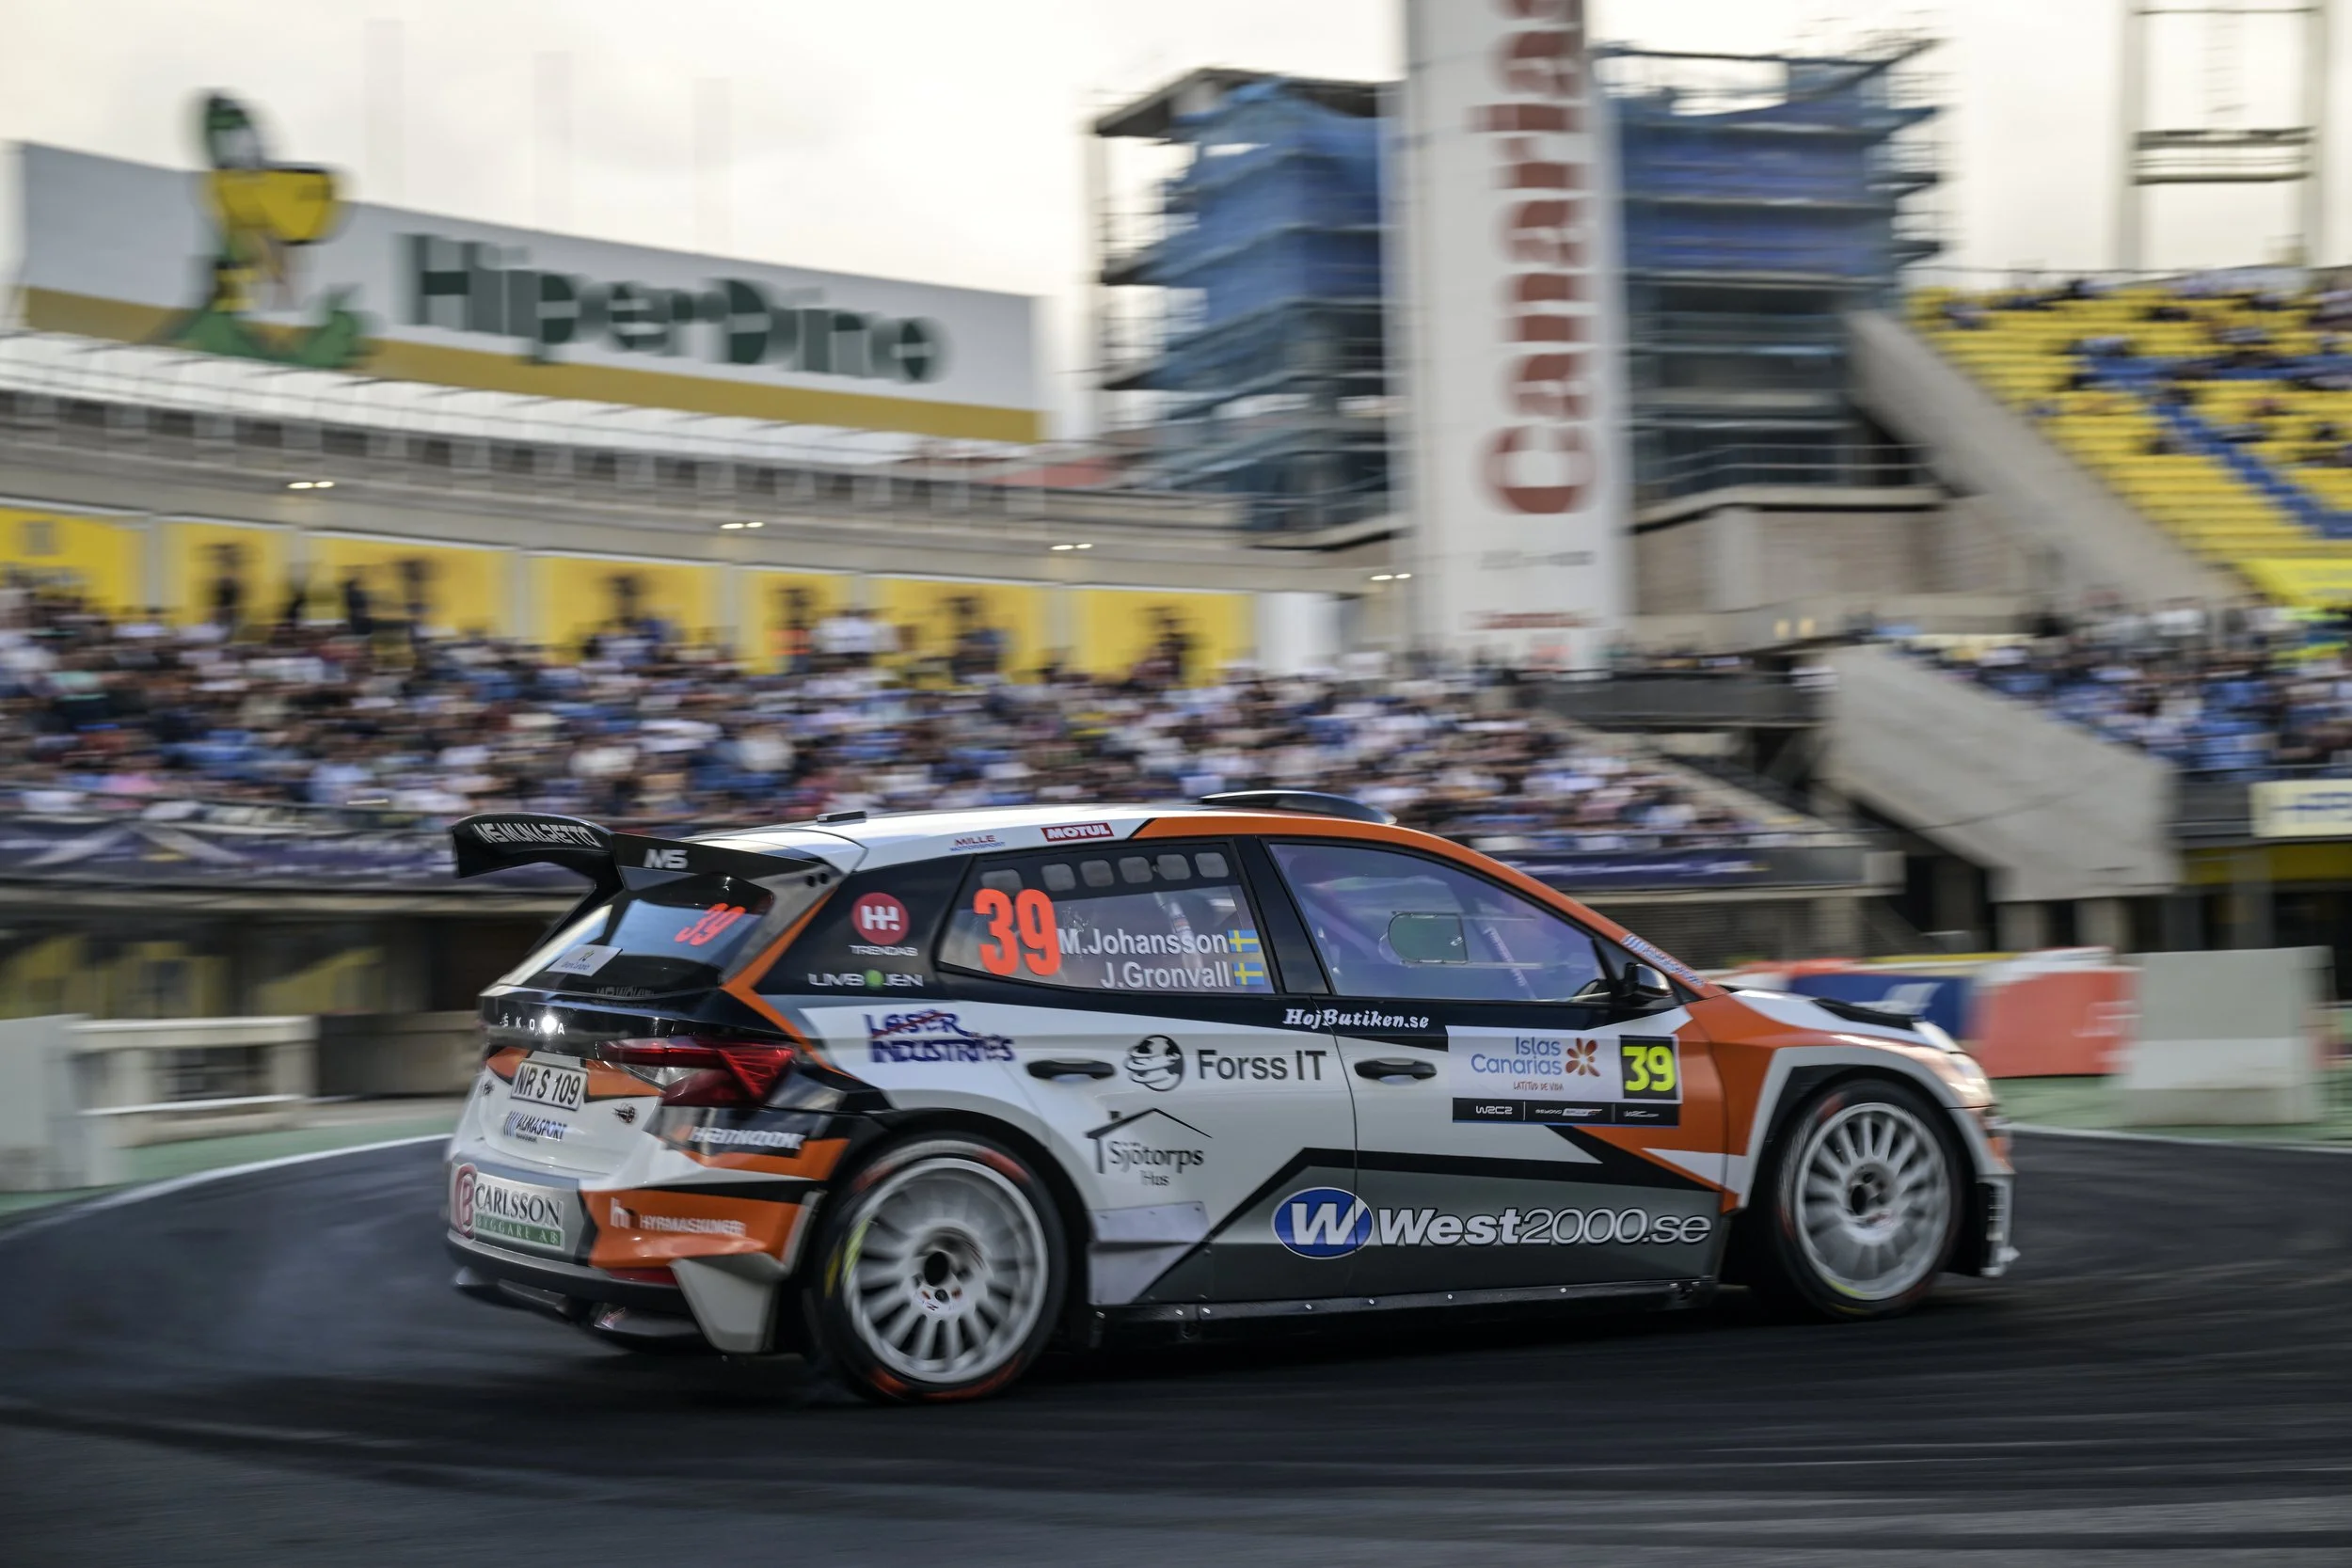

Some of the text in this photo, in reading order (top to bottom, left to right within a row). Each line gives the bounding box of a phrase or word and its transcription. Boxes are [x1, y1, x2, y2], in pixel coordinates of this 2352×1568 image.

[392, 232, 948, 384] HiperDino
[954, 834, 997, 846] MILLE
[1047, 824, 1111, 839] MOTUL
[675, 902, 746, 946] 39
[973, 888, 1061, 975] 39
[1057, 927, 1229, 955] M.Johansson
[1100, 960, 1231, 989] J.Gronvall
[864, 1009, 961, 1038] LASER
[1282, 1008, 1429, 1030] HojButiken.se
[869, 1035, 1016, 1064] INDUSTRIES
[1515, 1036, 1562, 1055] Islas
[1197, 1049, 1327, 1081] Forss IT
[1470, 1053, 1563, 1075] Canarias
[1621, 1045, 1677, 1093] 39
[514, 1065, 581, 1105] NR S 109
[1513, 1081, 1565, 1092] LATITUD DE VIDA
[1108, 1141, 1205, 1175] Sjötorps
[1140, 1170, 1170, 1186] Hus
[475, 1182, 564, 1227] CARLSSON
[475, 1213, 560, 1245] BYGGARE AB
[1291, 1201, 1367, 1246] W
[1376, 1207, 1712, 1247] West2000.se
